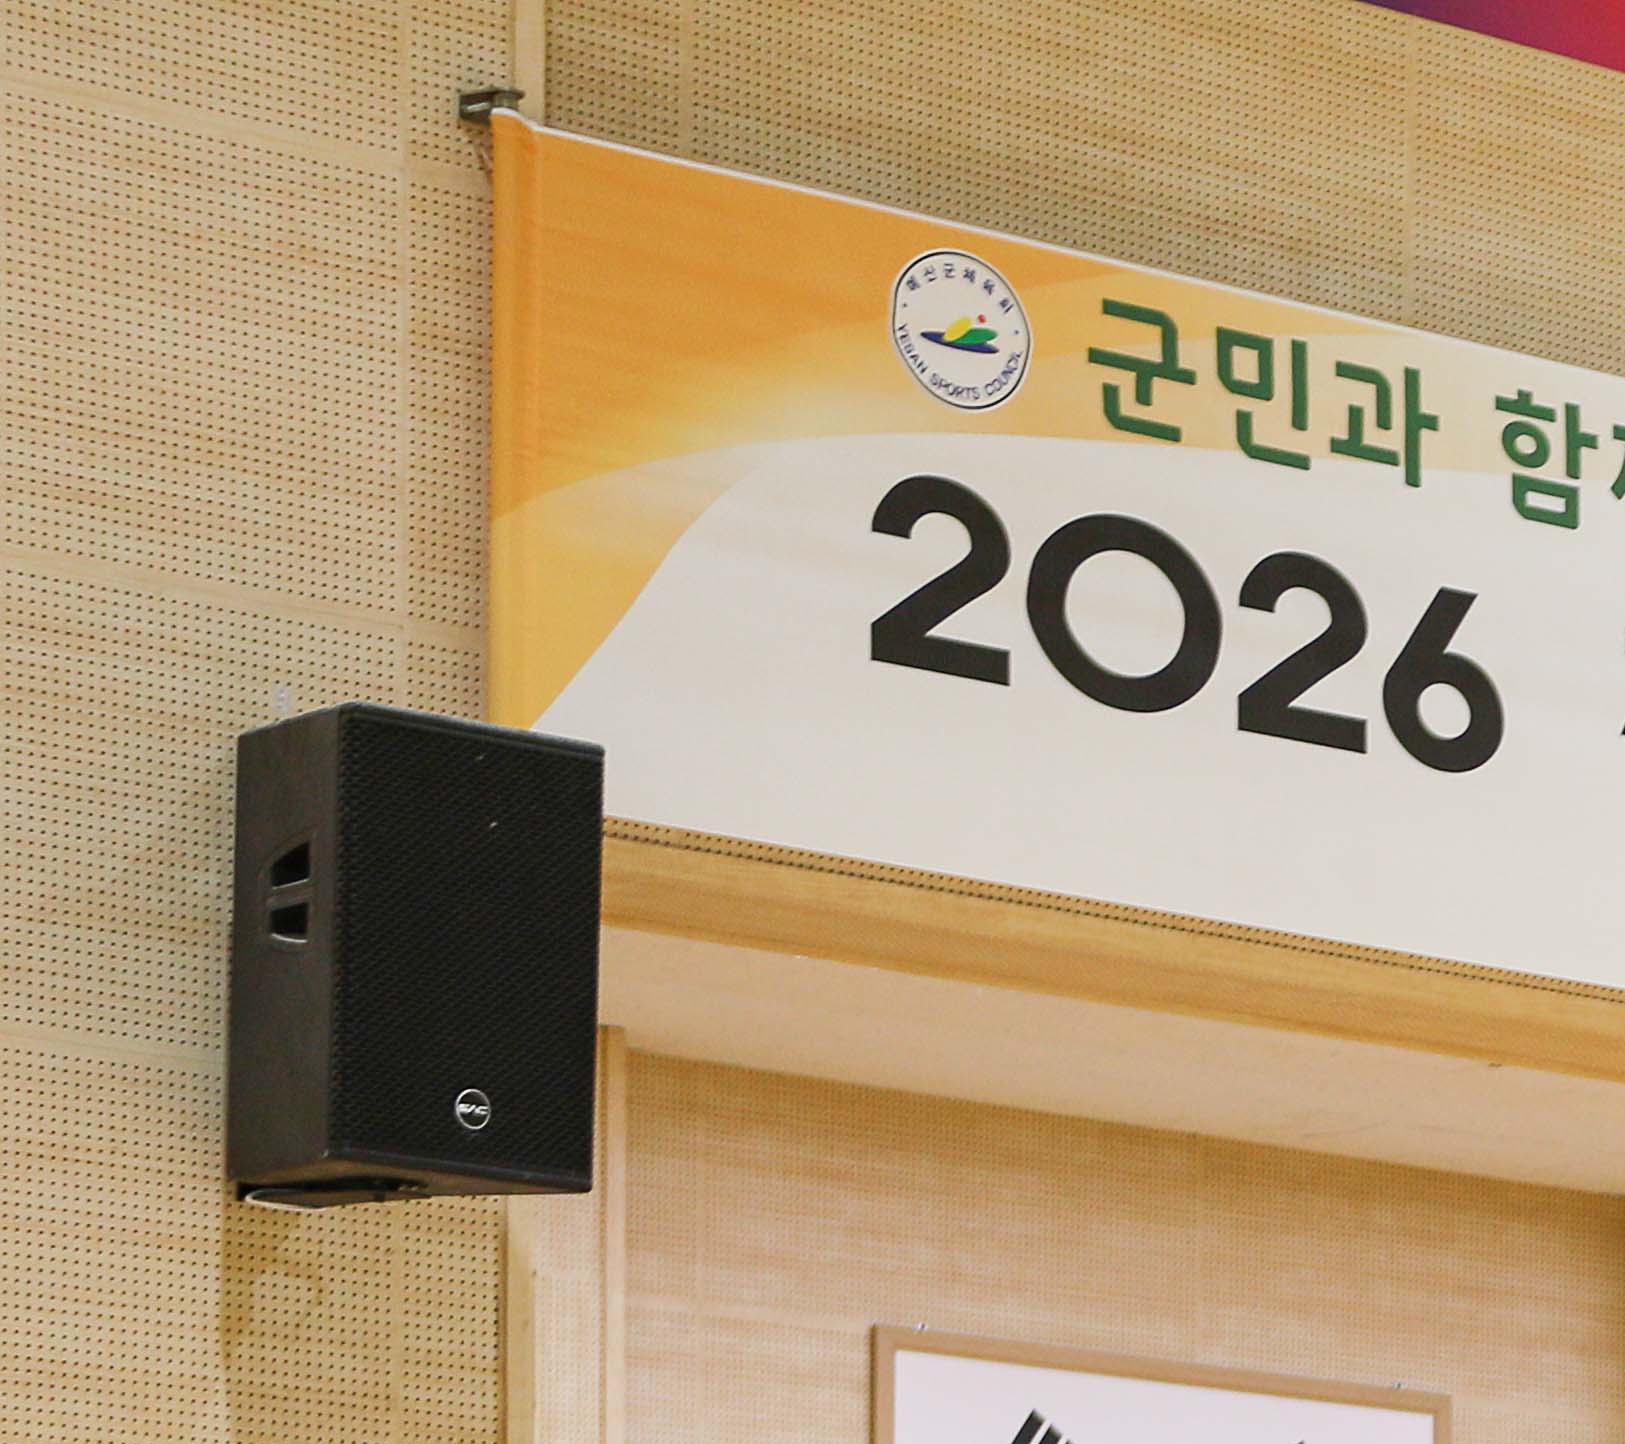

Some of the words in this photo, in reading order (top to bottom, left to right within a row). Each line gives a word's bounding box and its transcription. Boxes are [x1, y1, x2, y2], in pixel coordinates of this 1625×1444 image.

[930, 372, 979, 400] SPORTS
[1088, 298, 1439, 487] 군민과
[871, 474, 1504, 772] 2026
